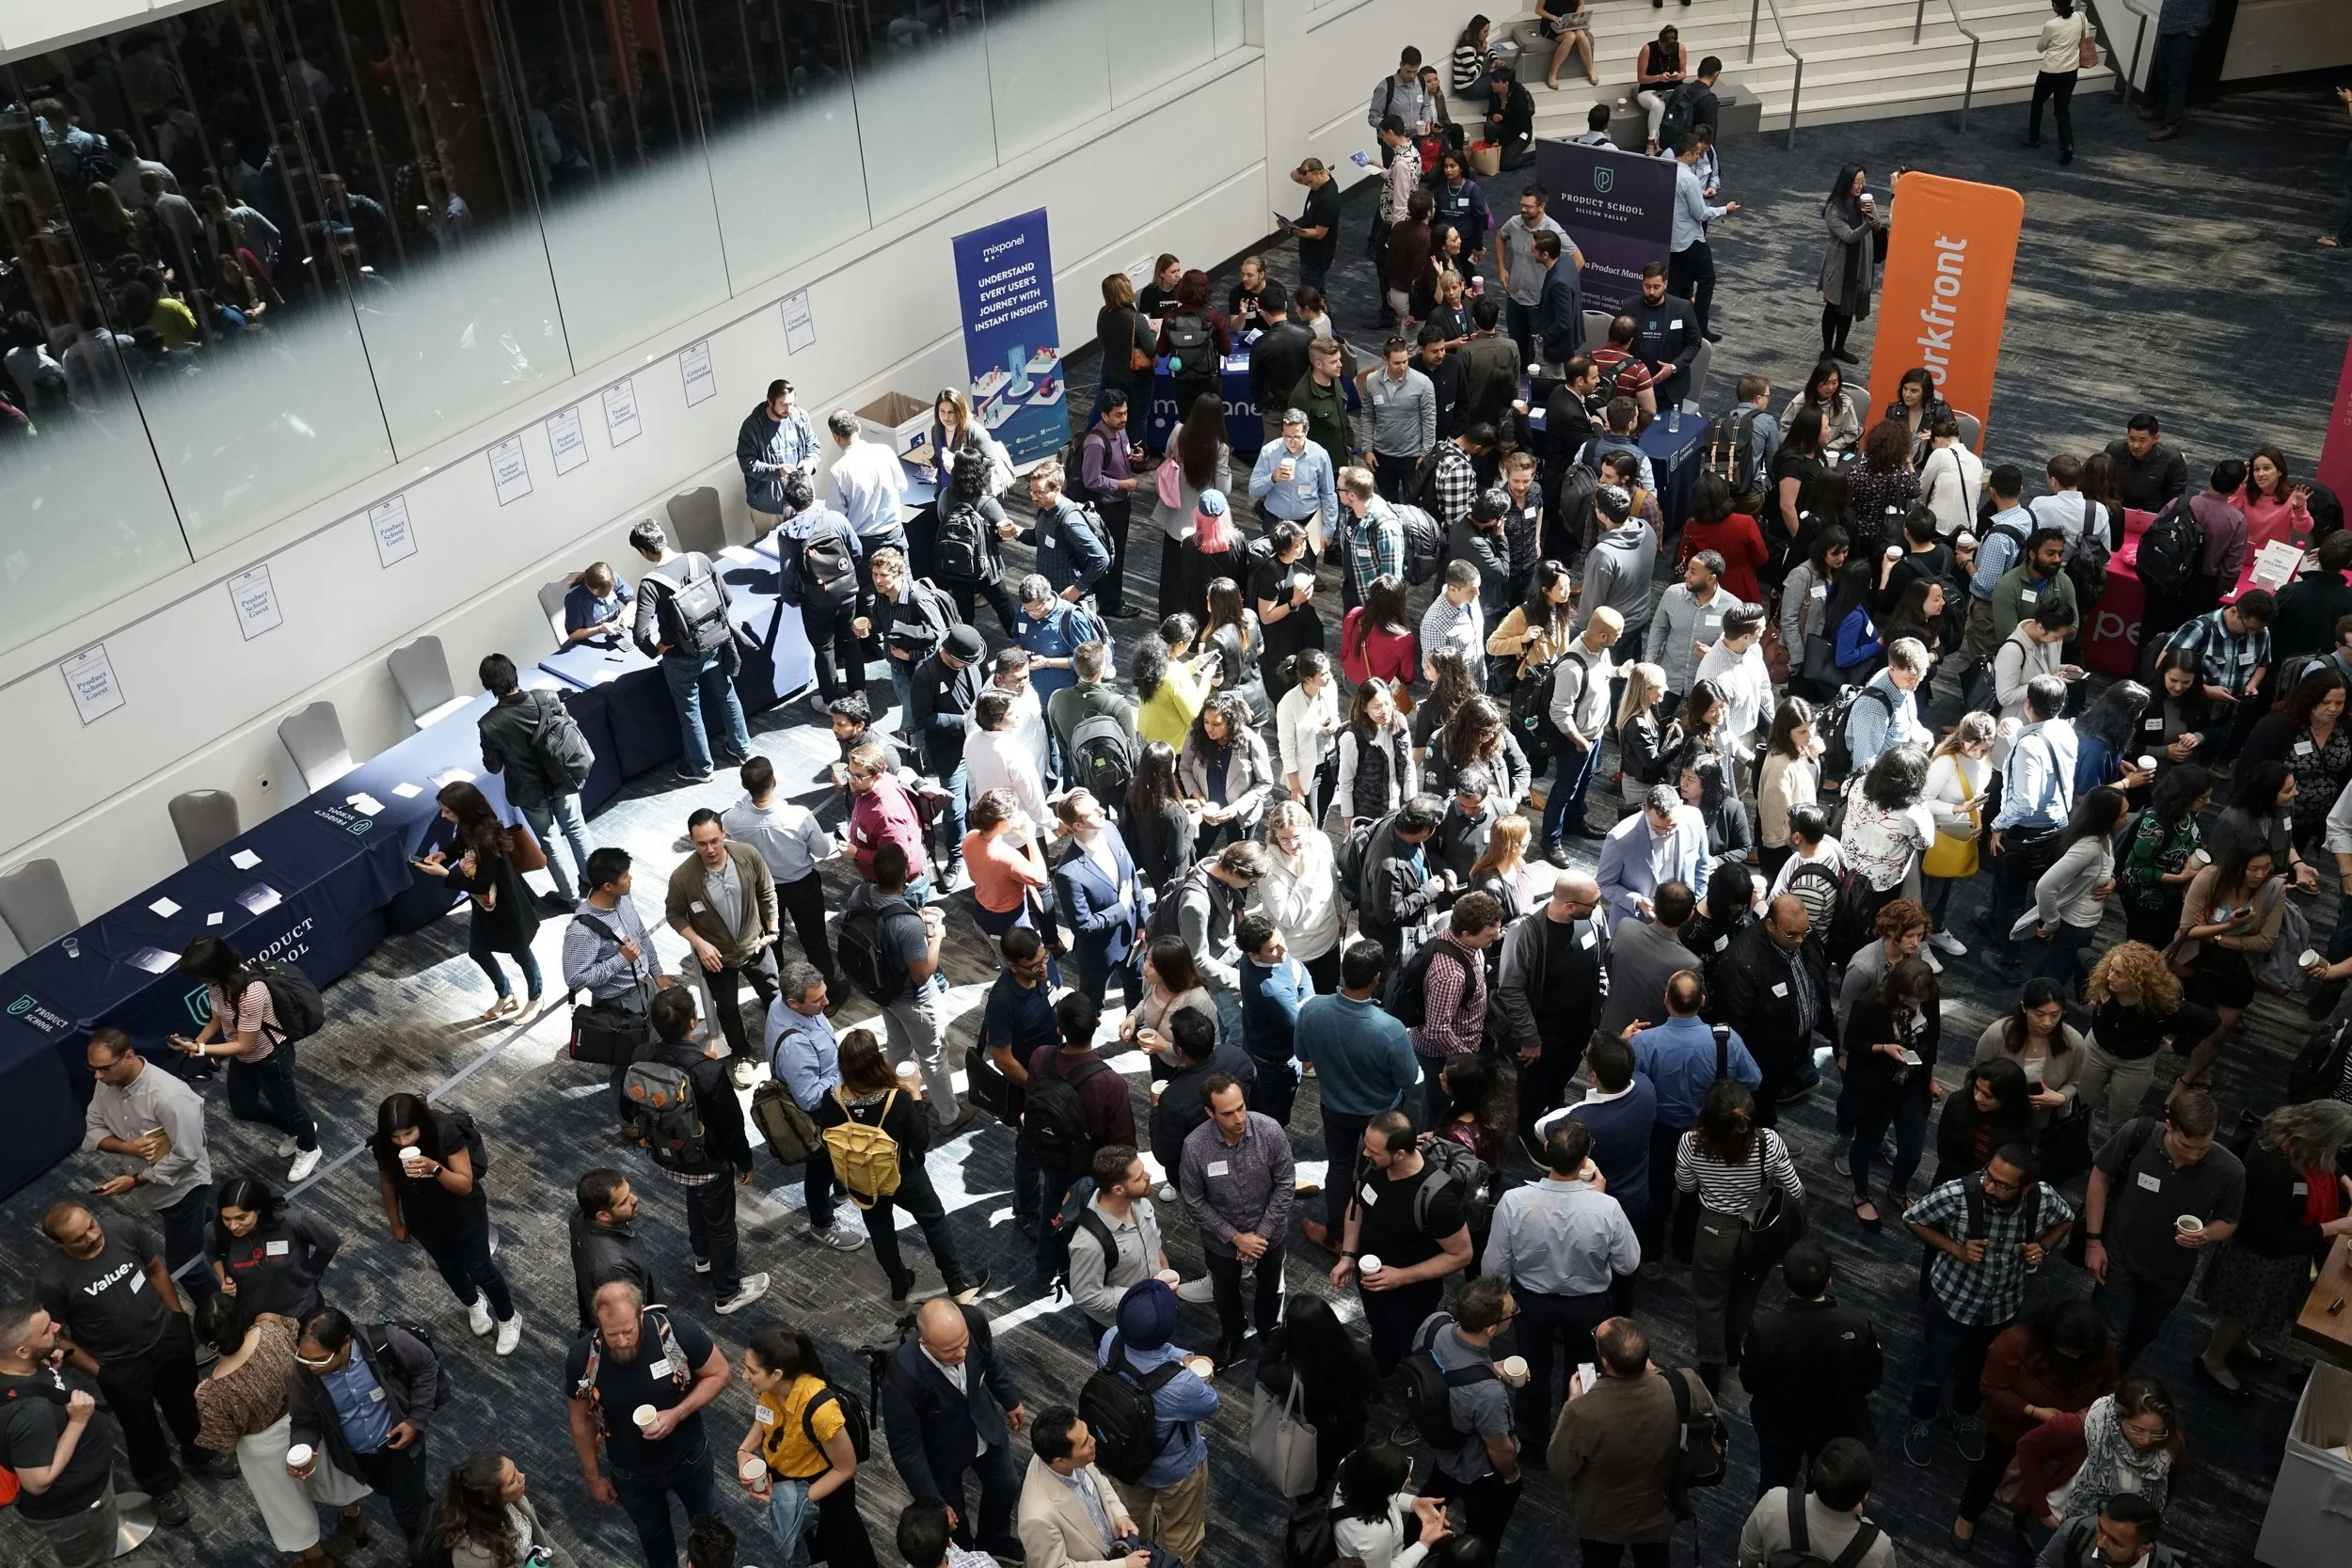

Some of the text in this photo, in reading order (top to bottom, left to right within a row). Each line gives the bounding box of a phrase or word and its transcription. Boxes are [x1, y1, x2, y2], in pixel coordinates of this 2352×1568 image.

[1562, 193, 1645, 215] PRODUCT SCHOOL
[1575, 208, 1628, 222] SILICON VALLEY
[983, 234, 1025, 256] mixpanel
[978, 262, 1035, 288] UNDERSTAND
[1591, 262, 1620, 275] Product
[1620, 269, 1644, 280] Mana
[980, 276, 1037, 302] EVERY USER'S
[979, 288, 1041, 317] JOURNEY WITH
[975, 299, 1048, 332] INSTANT INSIGHTS
[1916, 235, 1968, 400] orkfront
[687, 363, 707, 377] General
[1153, 399, 1263, 417] mane
[379, 520, 405, 536] Product
[383, 528, 405, 542] School
[386, 534, 405, 547] Guest
[241, 590, 268, 608] Product
[245, 598, 268, 612] School
[248, 605, 269, 619] Guest
[76, 671, 107, 690] Product
[81, 678, 107, 696] School
[86, 687, 109, 701] Guest
[313, 810, 348, 826] PRODUCT
[327, 806, 356, 820] SCHOOL
[24, 1013, 54, 1033] SCHOOL
[34, 1006, 69, 1028] PRODUCT
